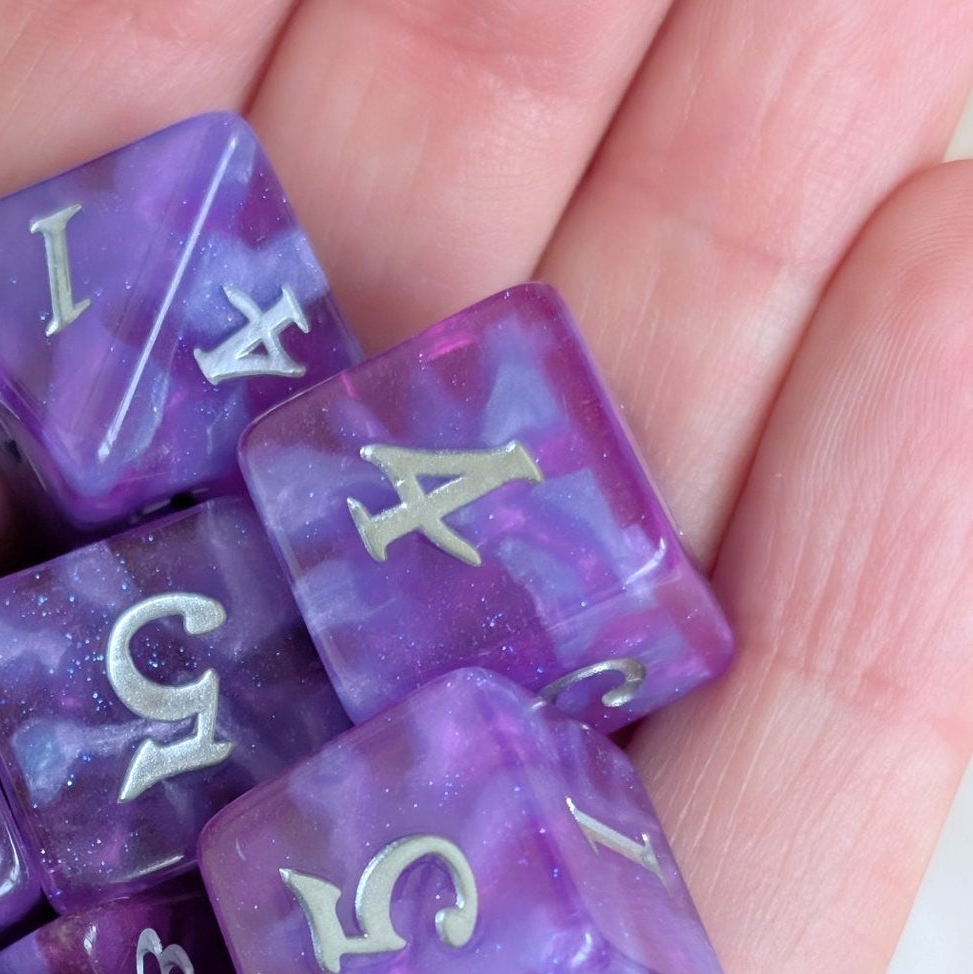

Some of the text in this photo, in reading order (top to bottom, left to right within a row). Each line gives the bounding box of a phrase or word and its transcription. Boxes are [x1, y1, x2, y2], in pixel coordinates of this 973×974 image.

[30, 203, 91, 337] 1
[193, 283, 310, 386] 4
[346, 439, 544, 568] 4
[105, 592, 234, 804] 5
[278, 834, 479, 974] 5
[565, 797, 671, 892] 1
